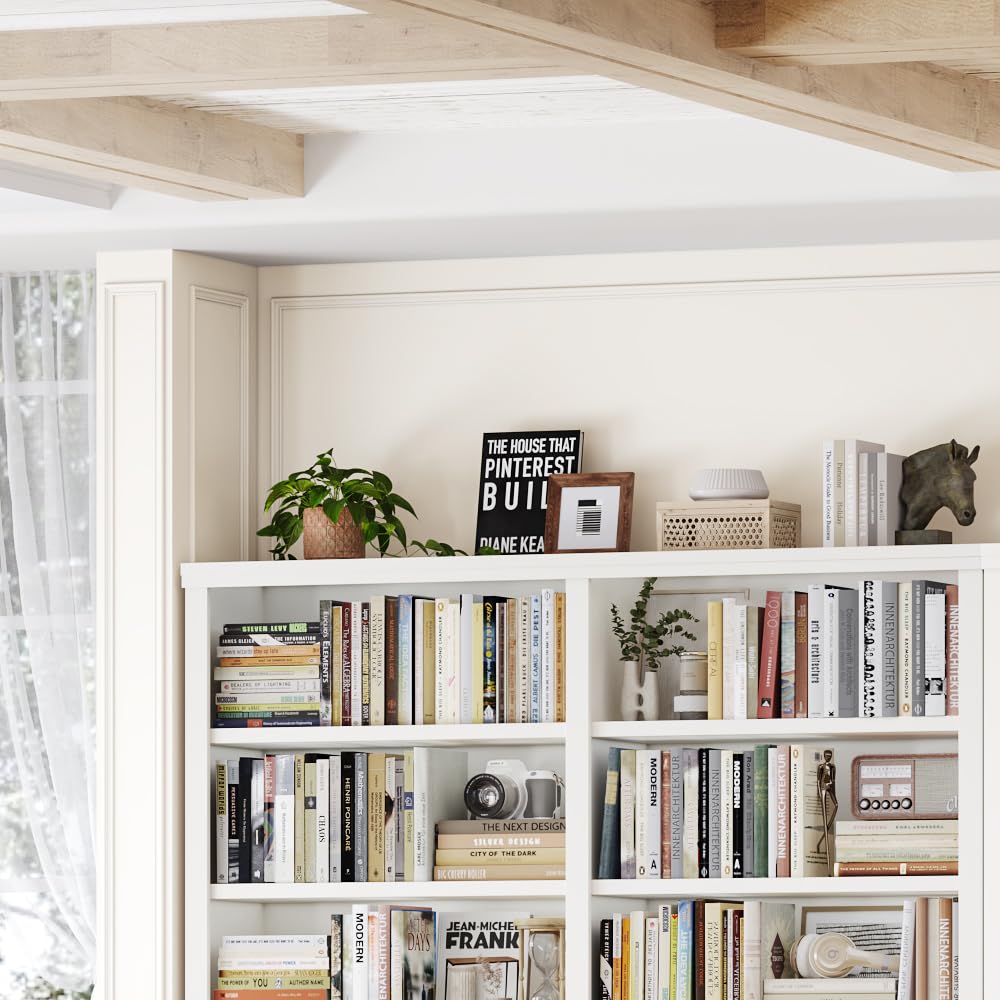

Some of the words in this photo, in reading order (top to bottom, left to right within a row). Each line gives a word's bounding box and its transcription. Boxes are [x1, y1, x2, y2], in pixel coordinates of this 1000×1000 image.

[487, 439, 509, 454] THE
[511, 438, 546, 454] HOUSE
[549, 437, 576, 453] THAT
[485, 456, 575, 478] PINTEREST
[483, 481, 548, 511] BUIL
[885, 602, 895, 709] INNENARCHITEKTUR
[949, 605, 959, 709] INNENARCHITEKTUR
[343, 660, 351, 692] ALGEBRA
[672, 756, 680, 860] INNENARCHITEKTUR
[711, 769, 720, 871] INNENARCHITEKTUR
[778, 753, 786, 858] INNENARCHITEKTUR
[483, 823, 500, 831] THE
[503, 823, 528, 831] NEXT
[531, 823, 566, 831] DESIGN
[355, 913, 364, 963] MODERN
[408, 933, 430, 951] DAYS
[445, 932, 519, 949] FRANK
[253, 979, 268, 987] YOU
